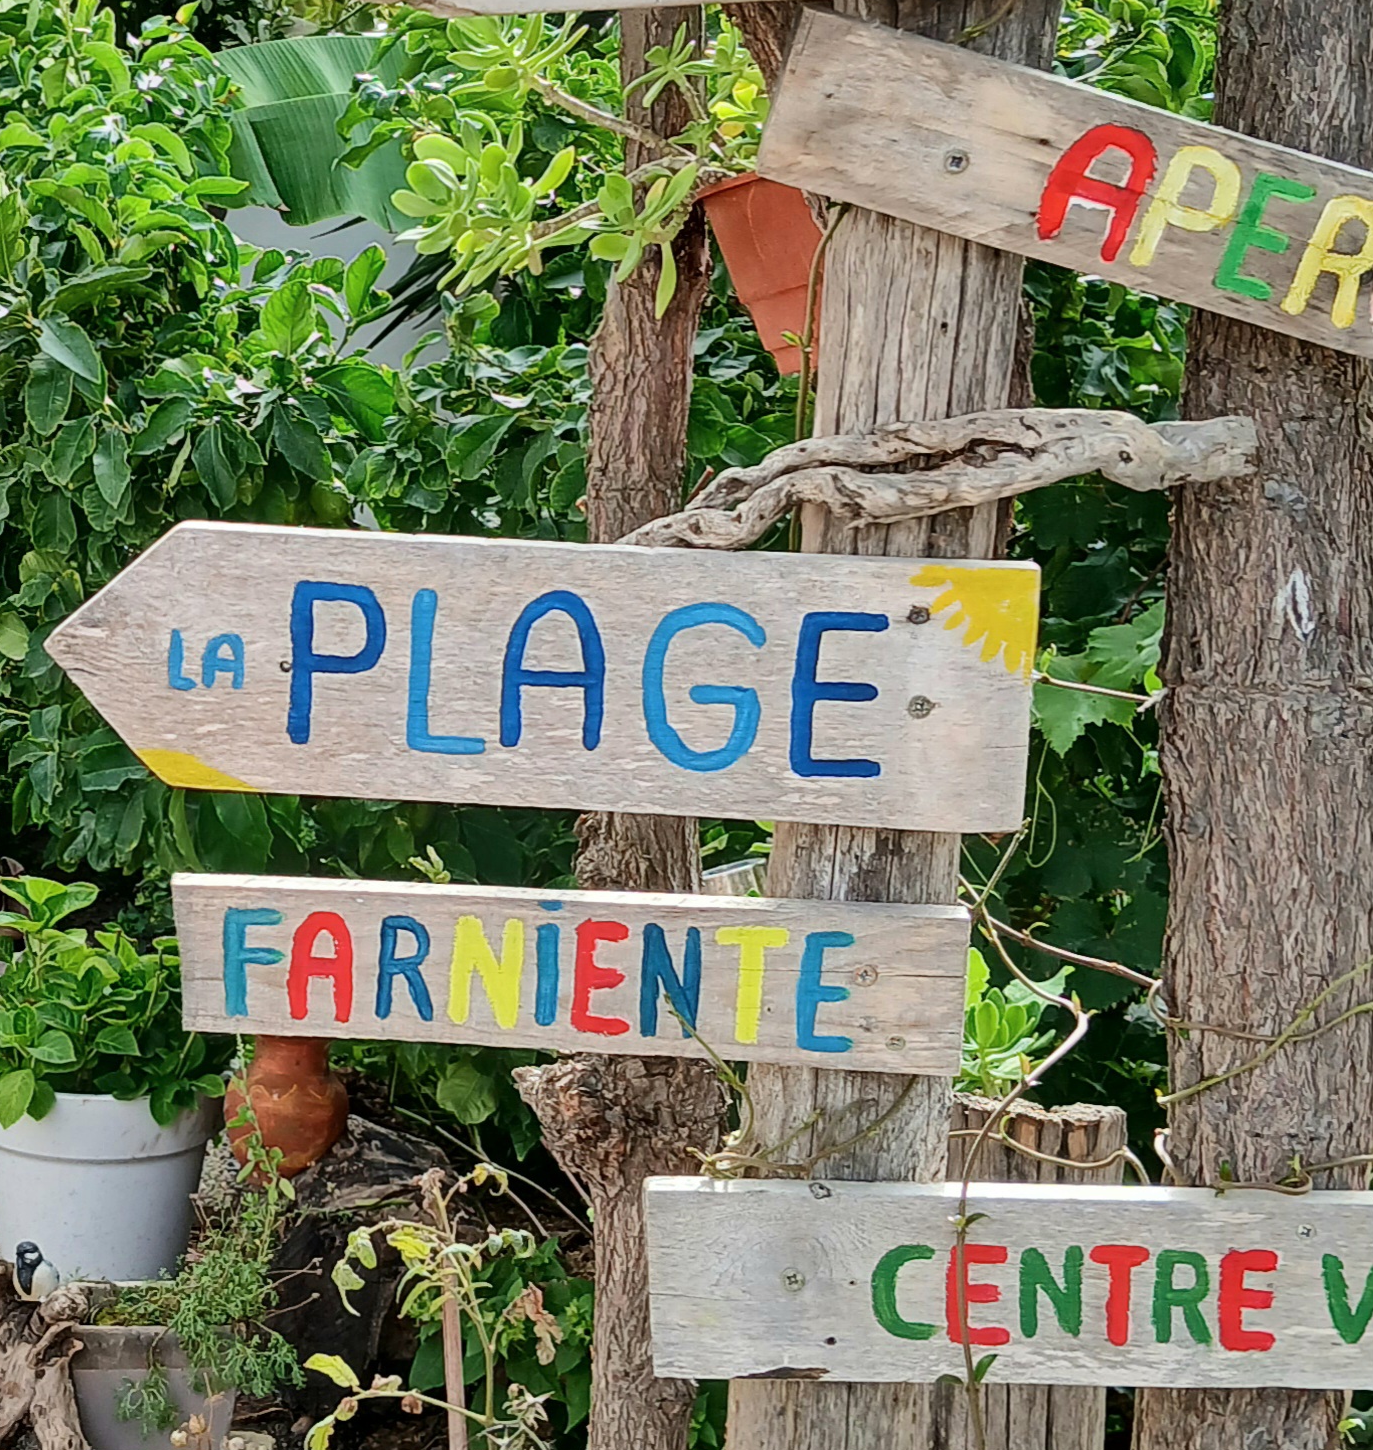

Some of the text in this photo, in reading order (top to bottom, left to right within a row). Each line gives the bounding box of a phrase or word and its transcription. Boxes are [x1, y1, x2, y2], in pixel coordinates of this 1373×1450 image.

[167, 580, 890, 778] LA PLAGE
[871, 1243, 1373, 1352] CENTRE V
